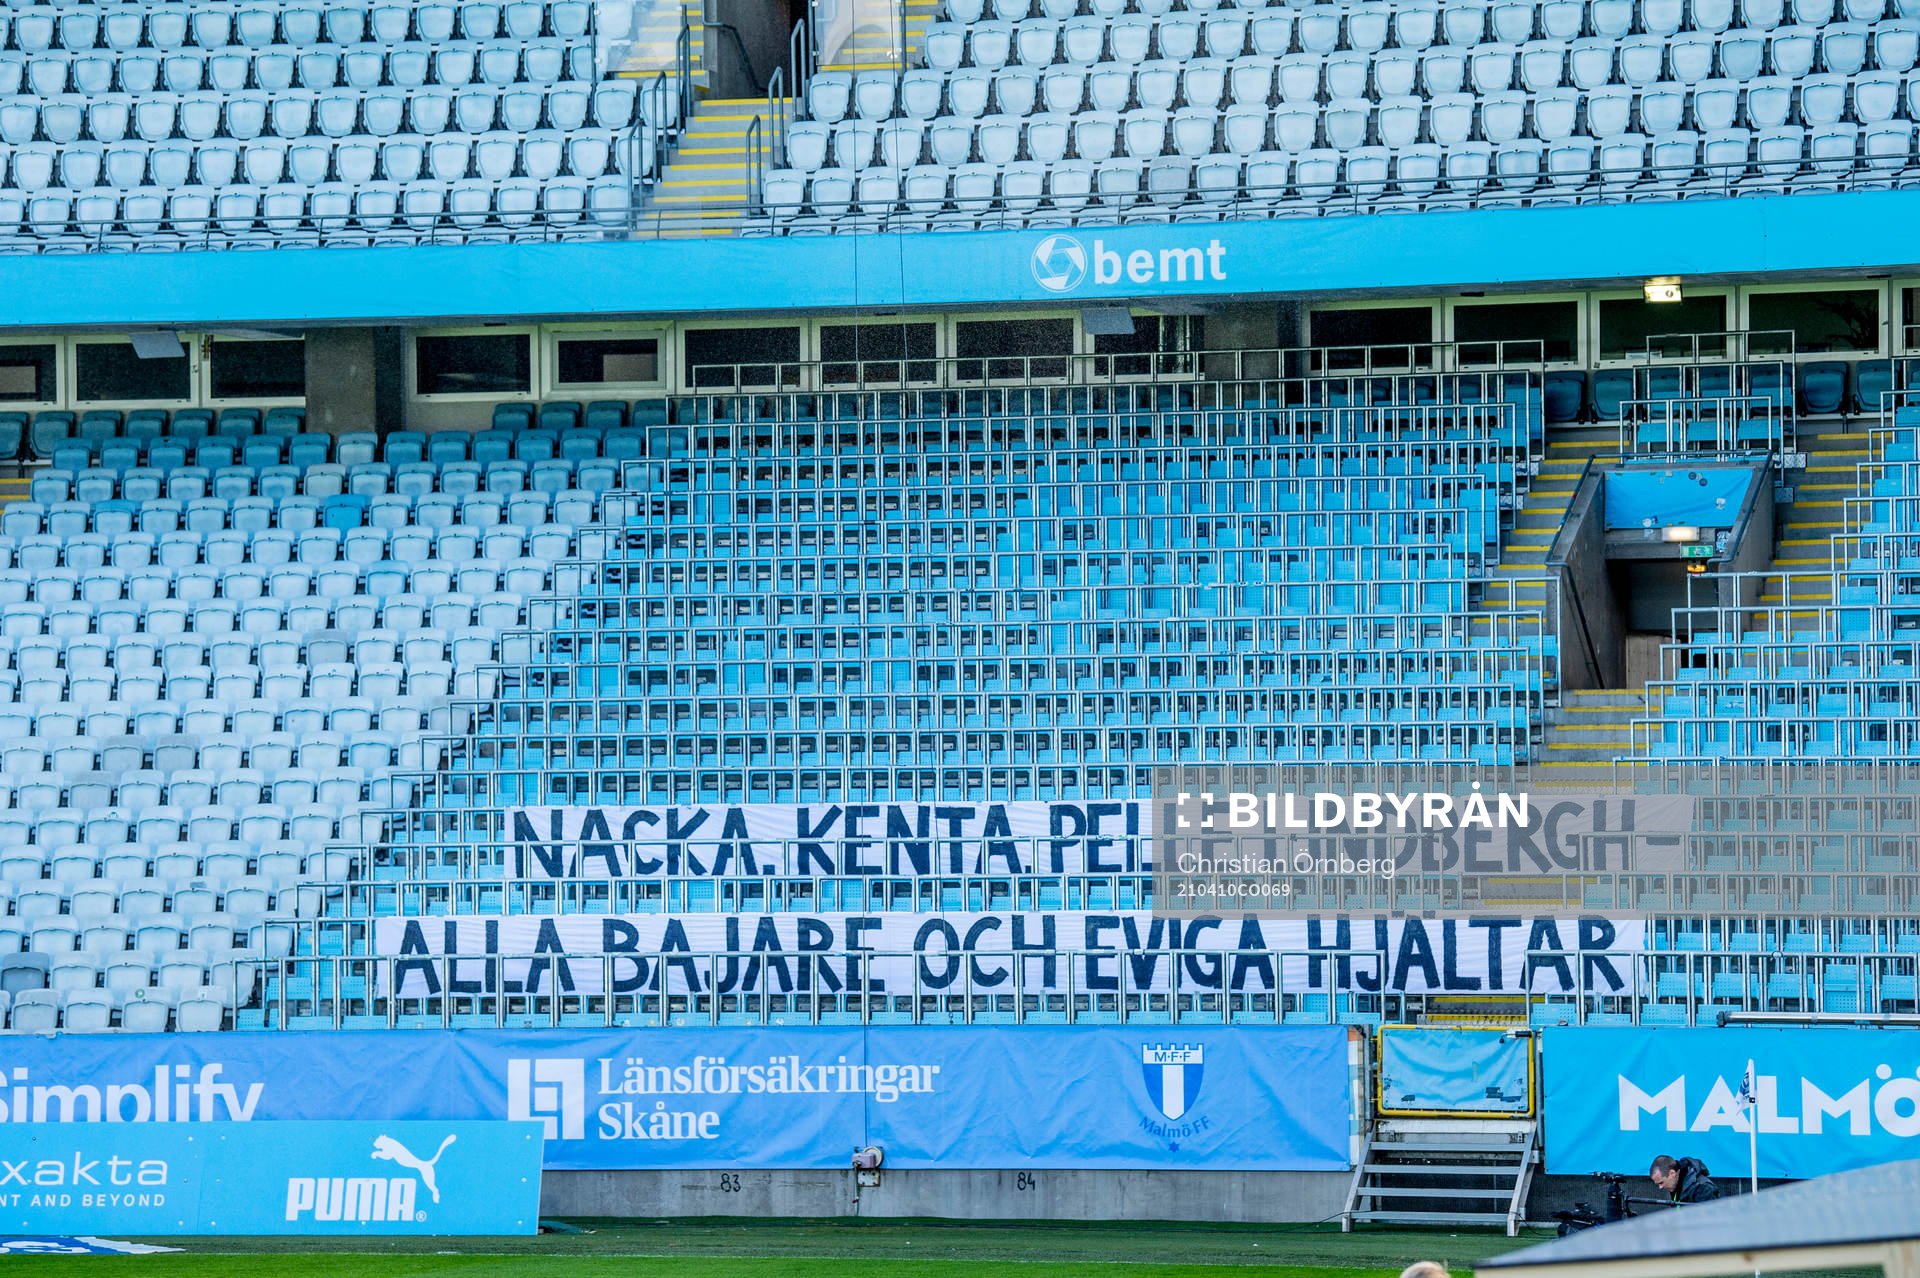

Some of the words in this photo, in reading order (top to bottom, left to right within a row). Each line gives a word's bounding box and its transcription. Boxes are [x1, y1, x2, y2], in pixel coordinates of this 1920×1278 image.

[1094, 239, 1227, 284] bemt
[396, 918, 575, 995] ALLA
[603, 916, 886, 994] BAJARE
[914, 915, 1056, 990] OCH
[1085, 914, 1275, 991] EVIGA
[0, 1063, 265, 1122] implify
[599, 1056, 940, 1103] Länsförsäkringar
[599, 1104, 720, 1141] Skåne
[1138, 1115, 1191, 1138] Malmö
[1192, 1115, 1211, 1135] FF
[720, 1173, 742, 1192] 83
[1017, 1171, 1036, 1191] 84
[31, 1194, 72, 1207] AND
[82, 1194, 165, 1207] BEYOND
